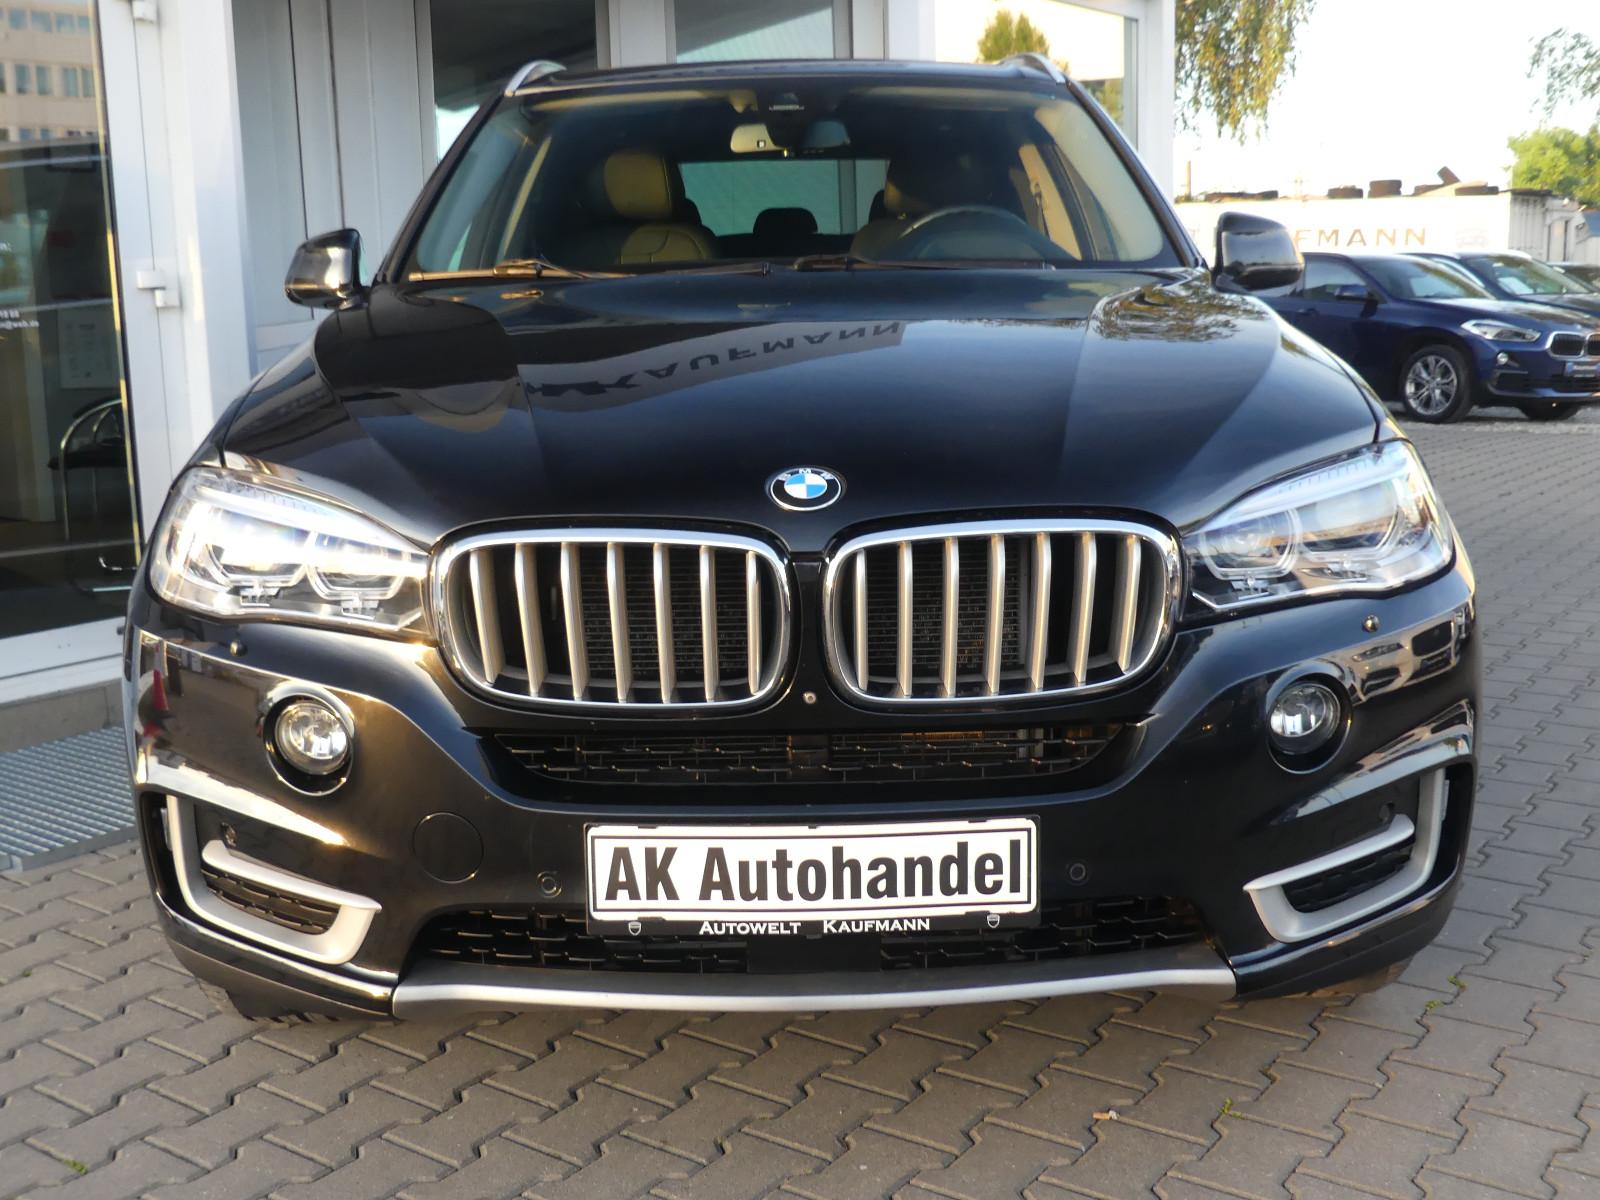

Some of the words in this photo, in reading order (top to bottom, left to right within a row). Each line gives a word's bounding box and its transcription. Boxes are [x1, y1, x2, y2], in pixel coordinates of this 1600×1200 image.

[604, 846, 680, 901] AK
[698, 838, 1021, 901] Autohandel
[699, 920, 802, 935] AUTOWELT
[823, 918, 931, 934] KAUFMANN
